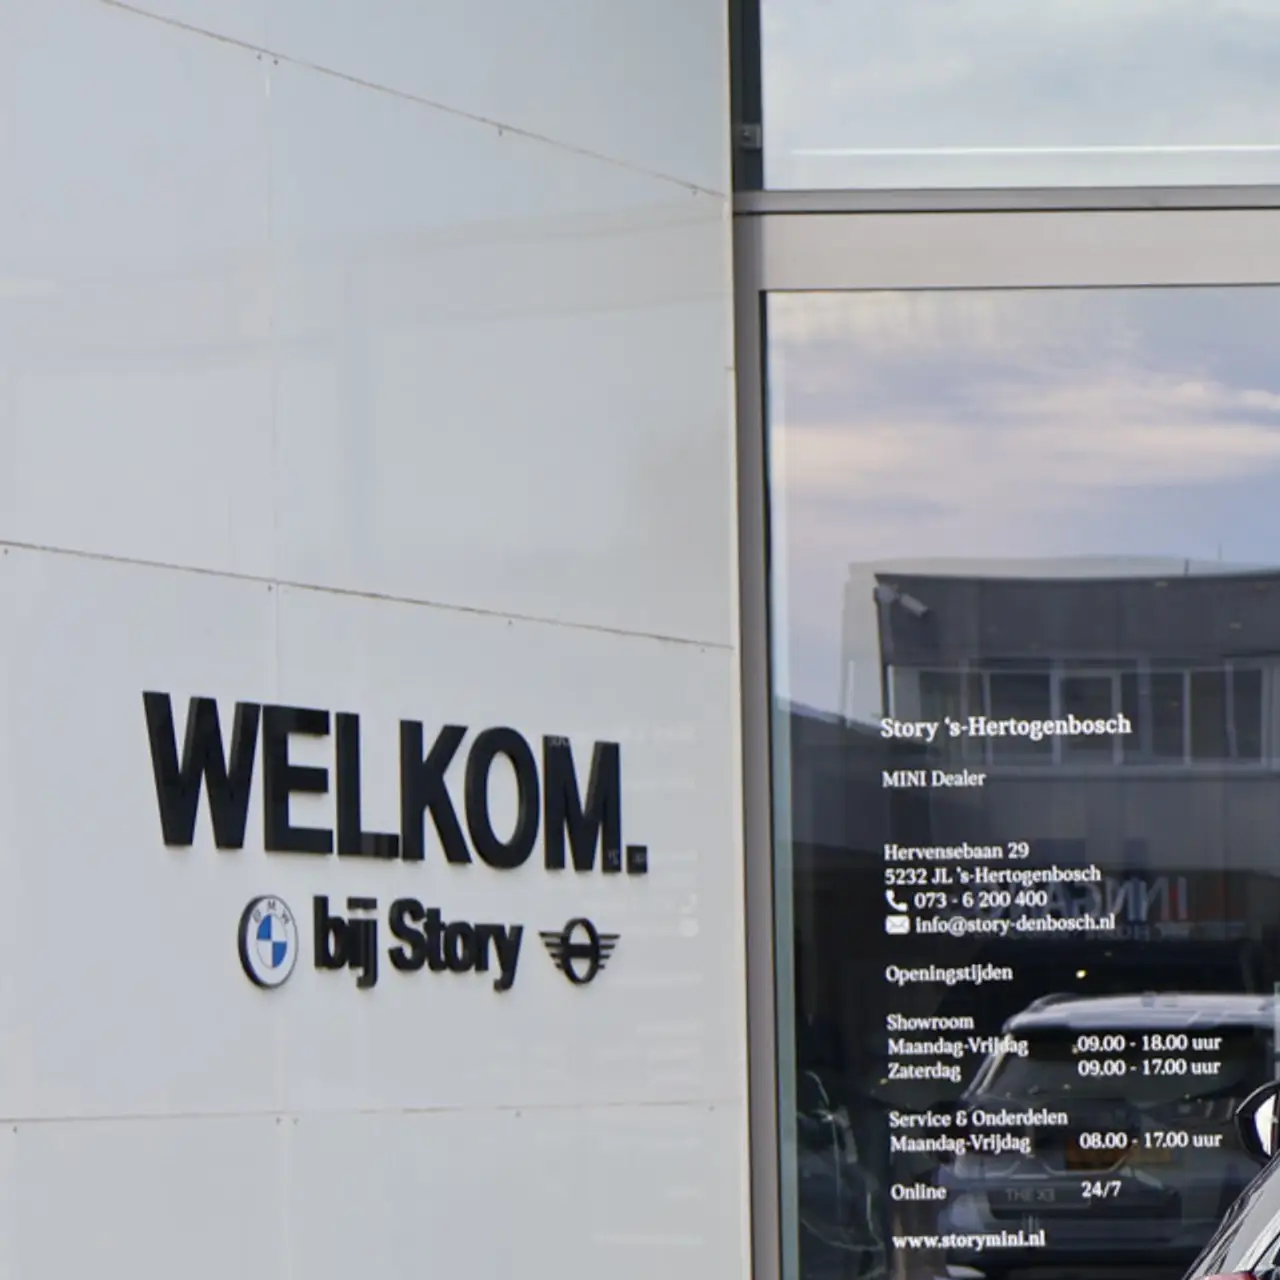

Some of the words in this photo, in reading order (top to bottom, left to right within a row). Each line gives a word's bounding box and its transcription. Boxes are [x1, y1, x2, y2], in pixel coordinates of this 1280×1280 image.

[880, 717, 938, 741] Story
[143, 691, 648, 873] WELKOM.
[883, 770, 926, 787] MINI
[933, 769, 986, 787] Dealer
[884, 842, 1003, 860] Hervensebaan
[1008, 842, 1030, 859] 29
[885, 868, 927, 885] 5232
[932, 867, 953, 884] JL
[914, 892, 947, 909] 073
[962, 891, 974, 908] 6
[978, 891, 1011, 908] 200
[1014, 890, 1048, 907] 400
[915, 914, 1116, 937] info@story-denbosch.nl
[314, 895, 378, 988] bij
[388, 899, 523, 991] Story
[885, 964, 1013, 986] Openingstijden
[887, 1014, 974, 1031] Showroom
[888, 1035, 1029, 1057] Maandag-Vrijdag
[1077, 1035, 1126, 1053] 09.00
[1143, 1034, 1188, 1051] 18.00
[1192, 1037, 1222, 1050] uur
[888, 1061, 962, 1082] Zaterdag
[1077, 1059, 1126, 1077] 09.00
[1143, 1058, 1188, 1075] 17.00
[1191, 1061, 1221, 1075] uur
[889, 1111, 951, 1128] Service
[955, 1109, 968, 1126] &
[972, 1108, 1068, 1126] Onderdelen
[890, 1134, 1031, 1155] Maandag-Vrijdag
[1079, 1132, 1128, 1149] 08.00
[1144, 1131, 1189, 1148] 17.00
[1192, 1134, 1223, 1148] uur
[891, 1184, 947, 1200] Online
[1081, 1180, 1122, 1198] 24/7
[892, 1230, 1046, 1251] www.storymini.nl
